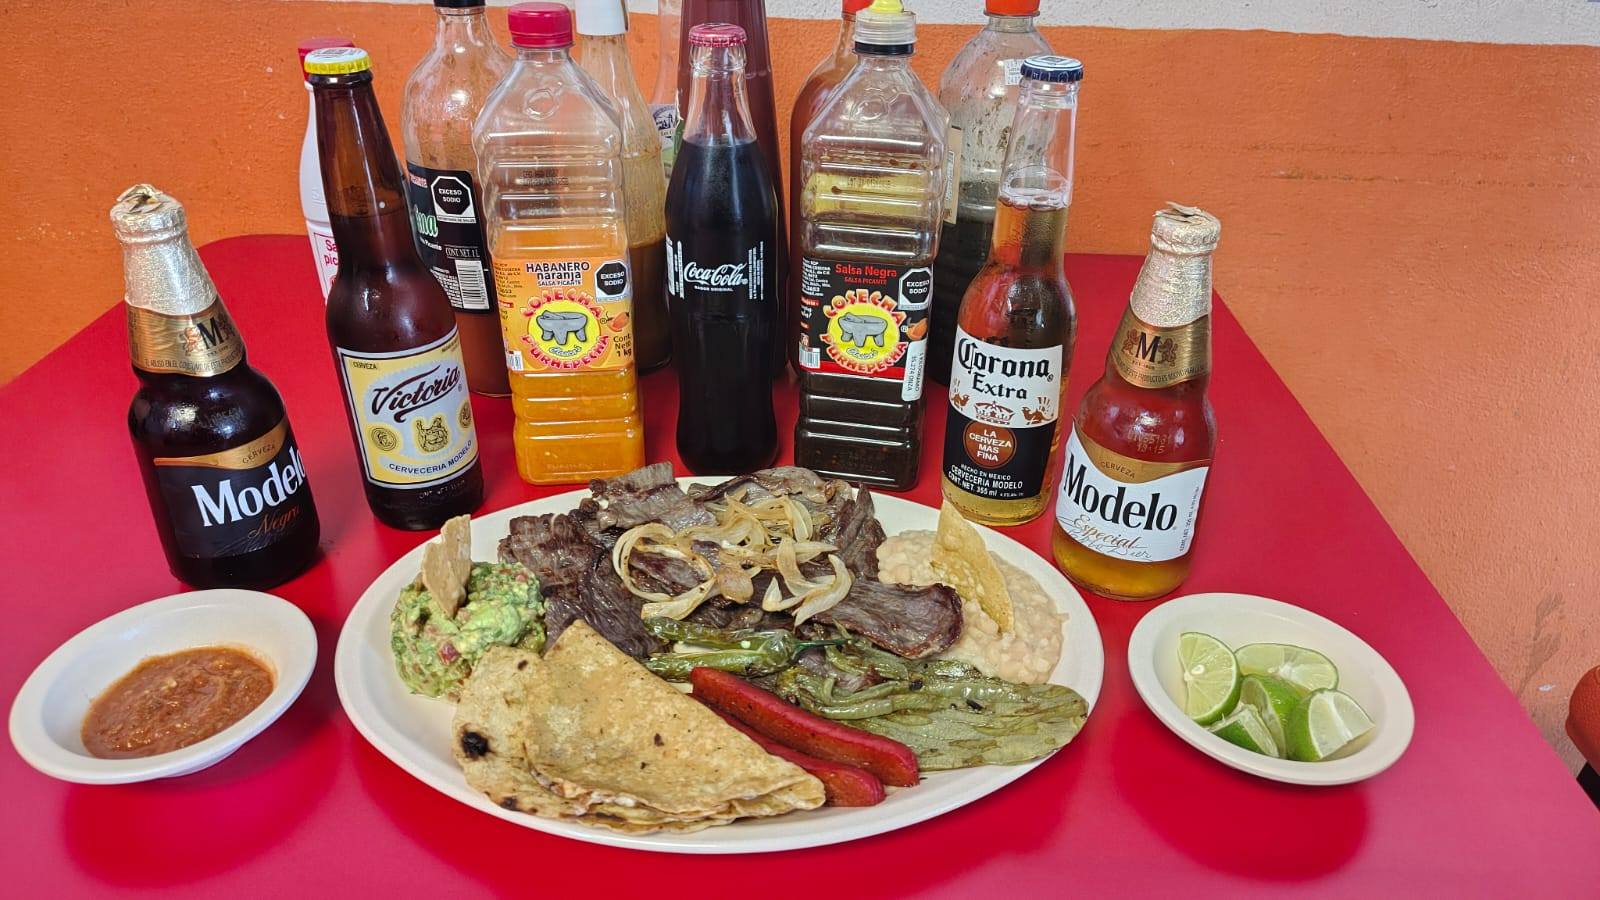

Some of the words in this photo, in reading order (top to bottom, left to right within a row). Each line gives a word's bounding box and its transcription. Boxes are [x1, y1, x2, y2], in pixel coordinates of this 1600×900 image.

[526, 261, 590, 274] HABANERO
[537, 269, 581, 284] naranja
[600, 271, 625, 280] EXCESO
[684, 261, 747, 287] Coca-Cola
[835, 263, 862, 276] Salsa
[865, 265, 898, 281] Negra
[604, 279, 624, 287] SODIO
[906, 279, 930, 288] EXCESO
[909, 287, 928, 295] SODIO
[519, 288, 605, 320] COSECHA
[822, 288, 907, 327] COSECHA
[196, 316, 225, 350] M
[1135, 331, 1161, 363] M
[352, 361, 377, 370] CERVEZA
[957, 337, 1049, 379] Corona
[371, 365, 460, 423] Victoria
[972, 371, 1028, 400] Extra
[969, 432, 1012, 448] CERVEZA
[983, 429, 996, 438] LA
[242, 444, 275, 464] CERVEZA
[389, 462, 447, 476] CERVECERIA
[447, 439, 472, 467] MODELO
[976, 451, 999, 462] FINA
[977, 443, 1000, 454] MAS
[951, 464, 990, 488] CERVECERIA
[992, 479, 1023, 490] MODELO
[960, 463, 978, 475] HECHO
[979, 470, 987, 478] EN
[1100, 461, 1135, 479] CERVEZA
[1064, 451, 1178, 532] Modelo
[1073, 513, 1147, 550] Especial
